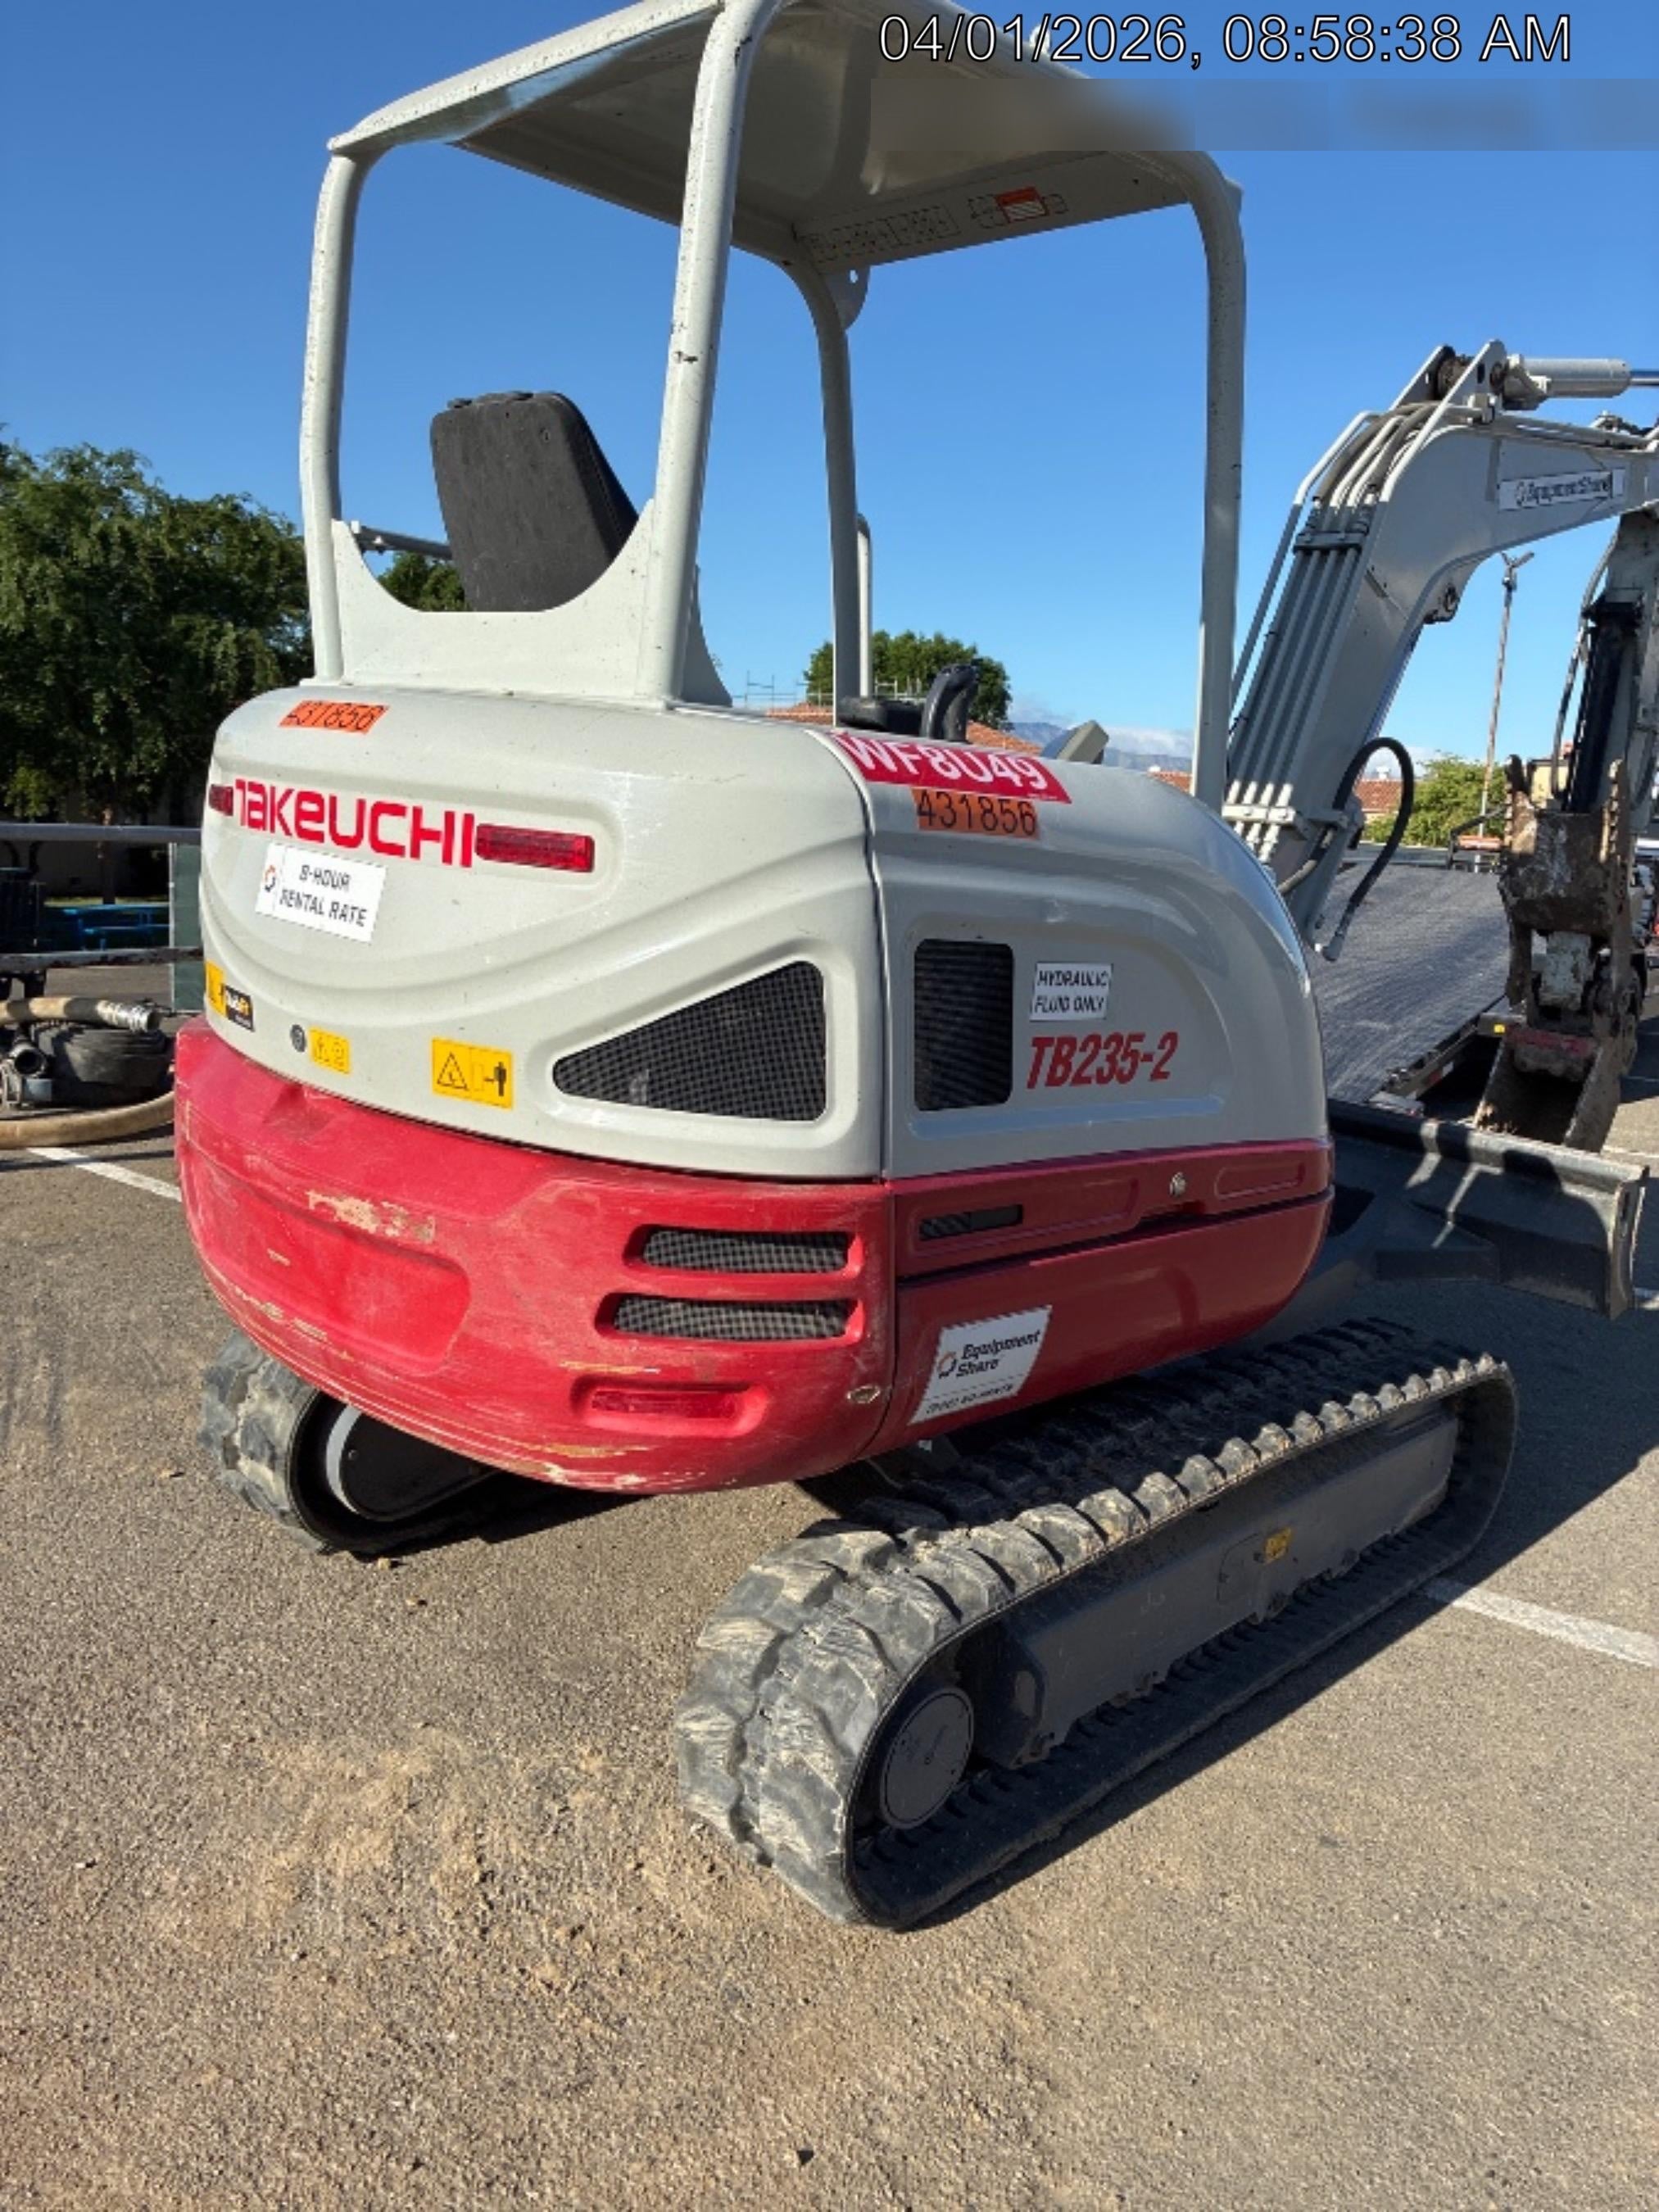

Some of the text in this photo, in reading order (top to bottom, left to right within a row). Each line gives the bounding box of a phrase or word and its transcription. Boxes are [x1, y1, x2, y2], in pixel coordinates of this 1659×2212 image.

[835, 732, 1049, 791] WF8U49
[916, 788, 1038, 836] 431856
[298, 863, 351, 892] 8-HOUR
[279, 888, 368, 927] RENTAL RATE
[1037, 969, 1108, 986] HYDRAULIC
[1034, 994, 1105, 1013] FLUID ONLY
[1026, 1031, 1180, 1090] TB235-2
[961, 1329, 1041, 1361] Equipment
[955, 1358, 1000, 1378] Share
